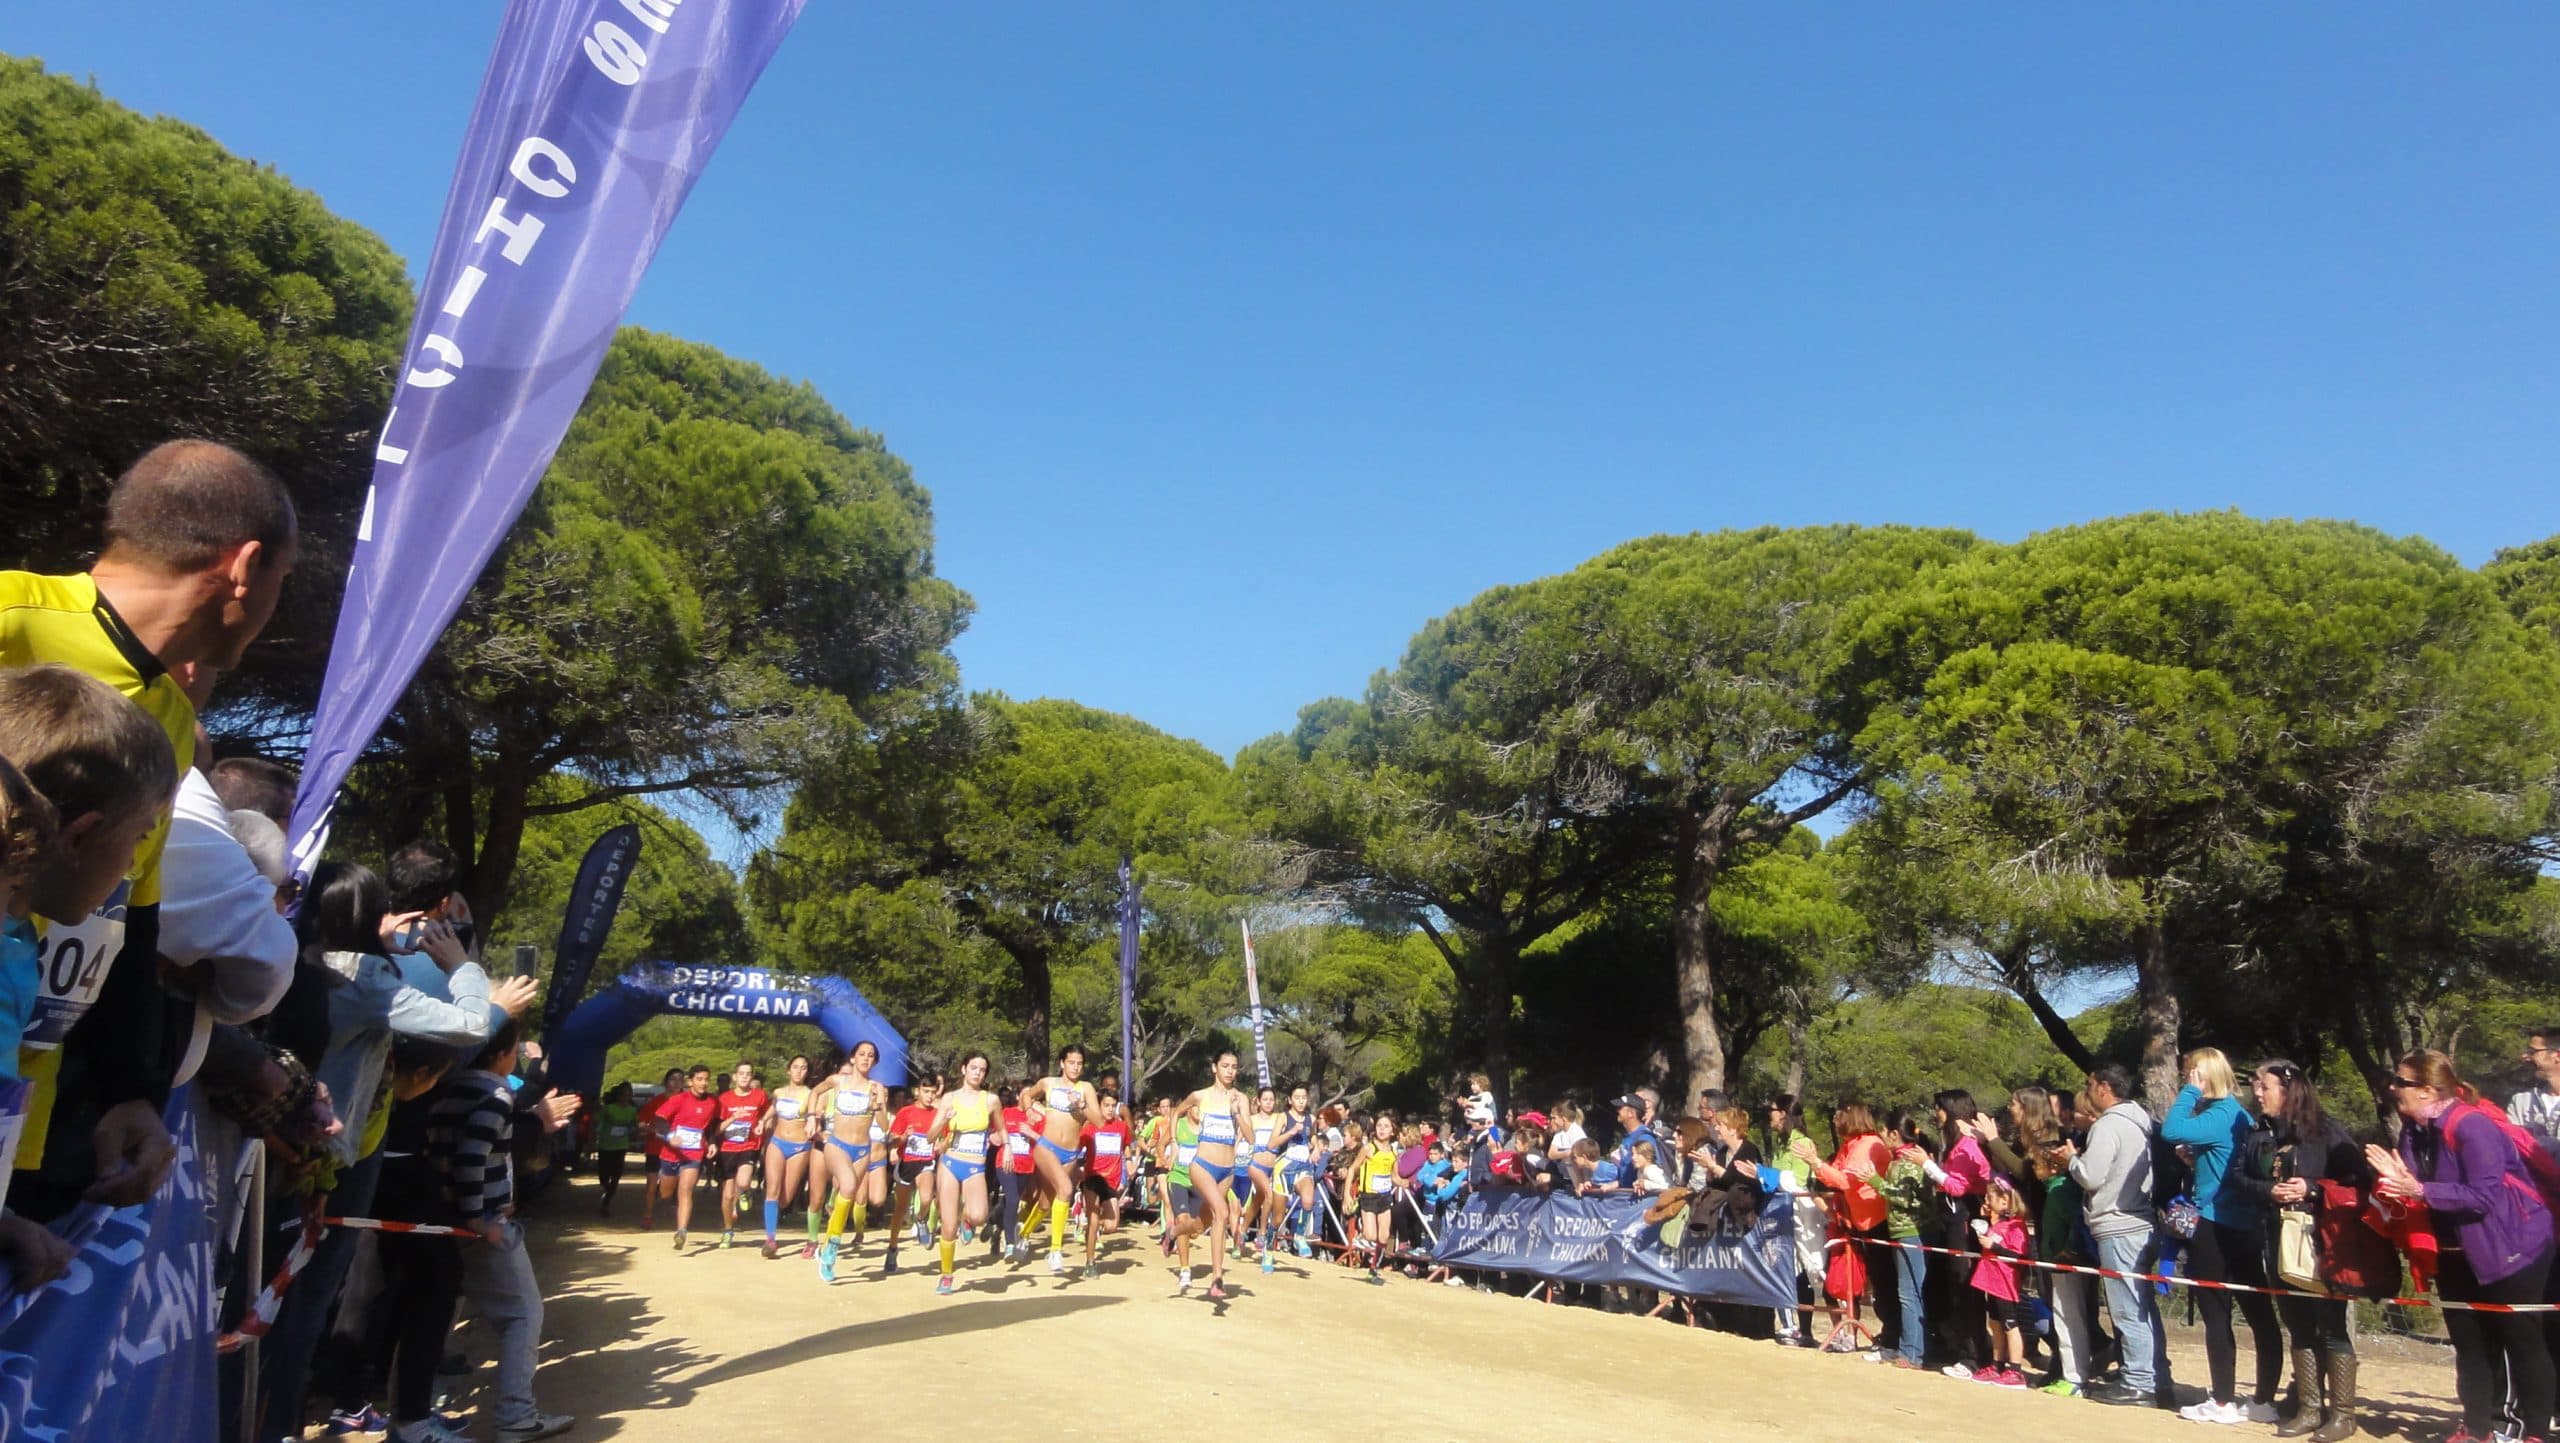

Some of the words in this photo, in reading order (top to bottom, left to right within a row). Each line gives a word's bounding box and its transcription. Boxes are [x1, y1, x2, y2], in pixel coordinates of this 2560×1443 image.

[577, 835, 630, 943] DEPORTES
[668, 990, 810, 1017] CHICLANA
[1659, 1246, 1744, 1270] CHICLANA
